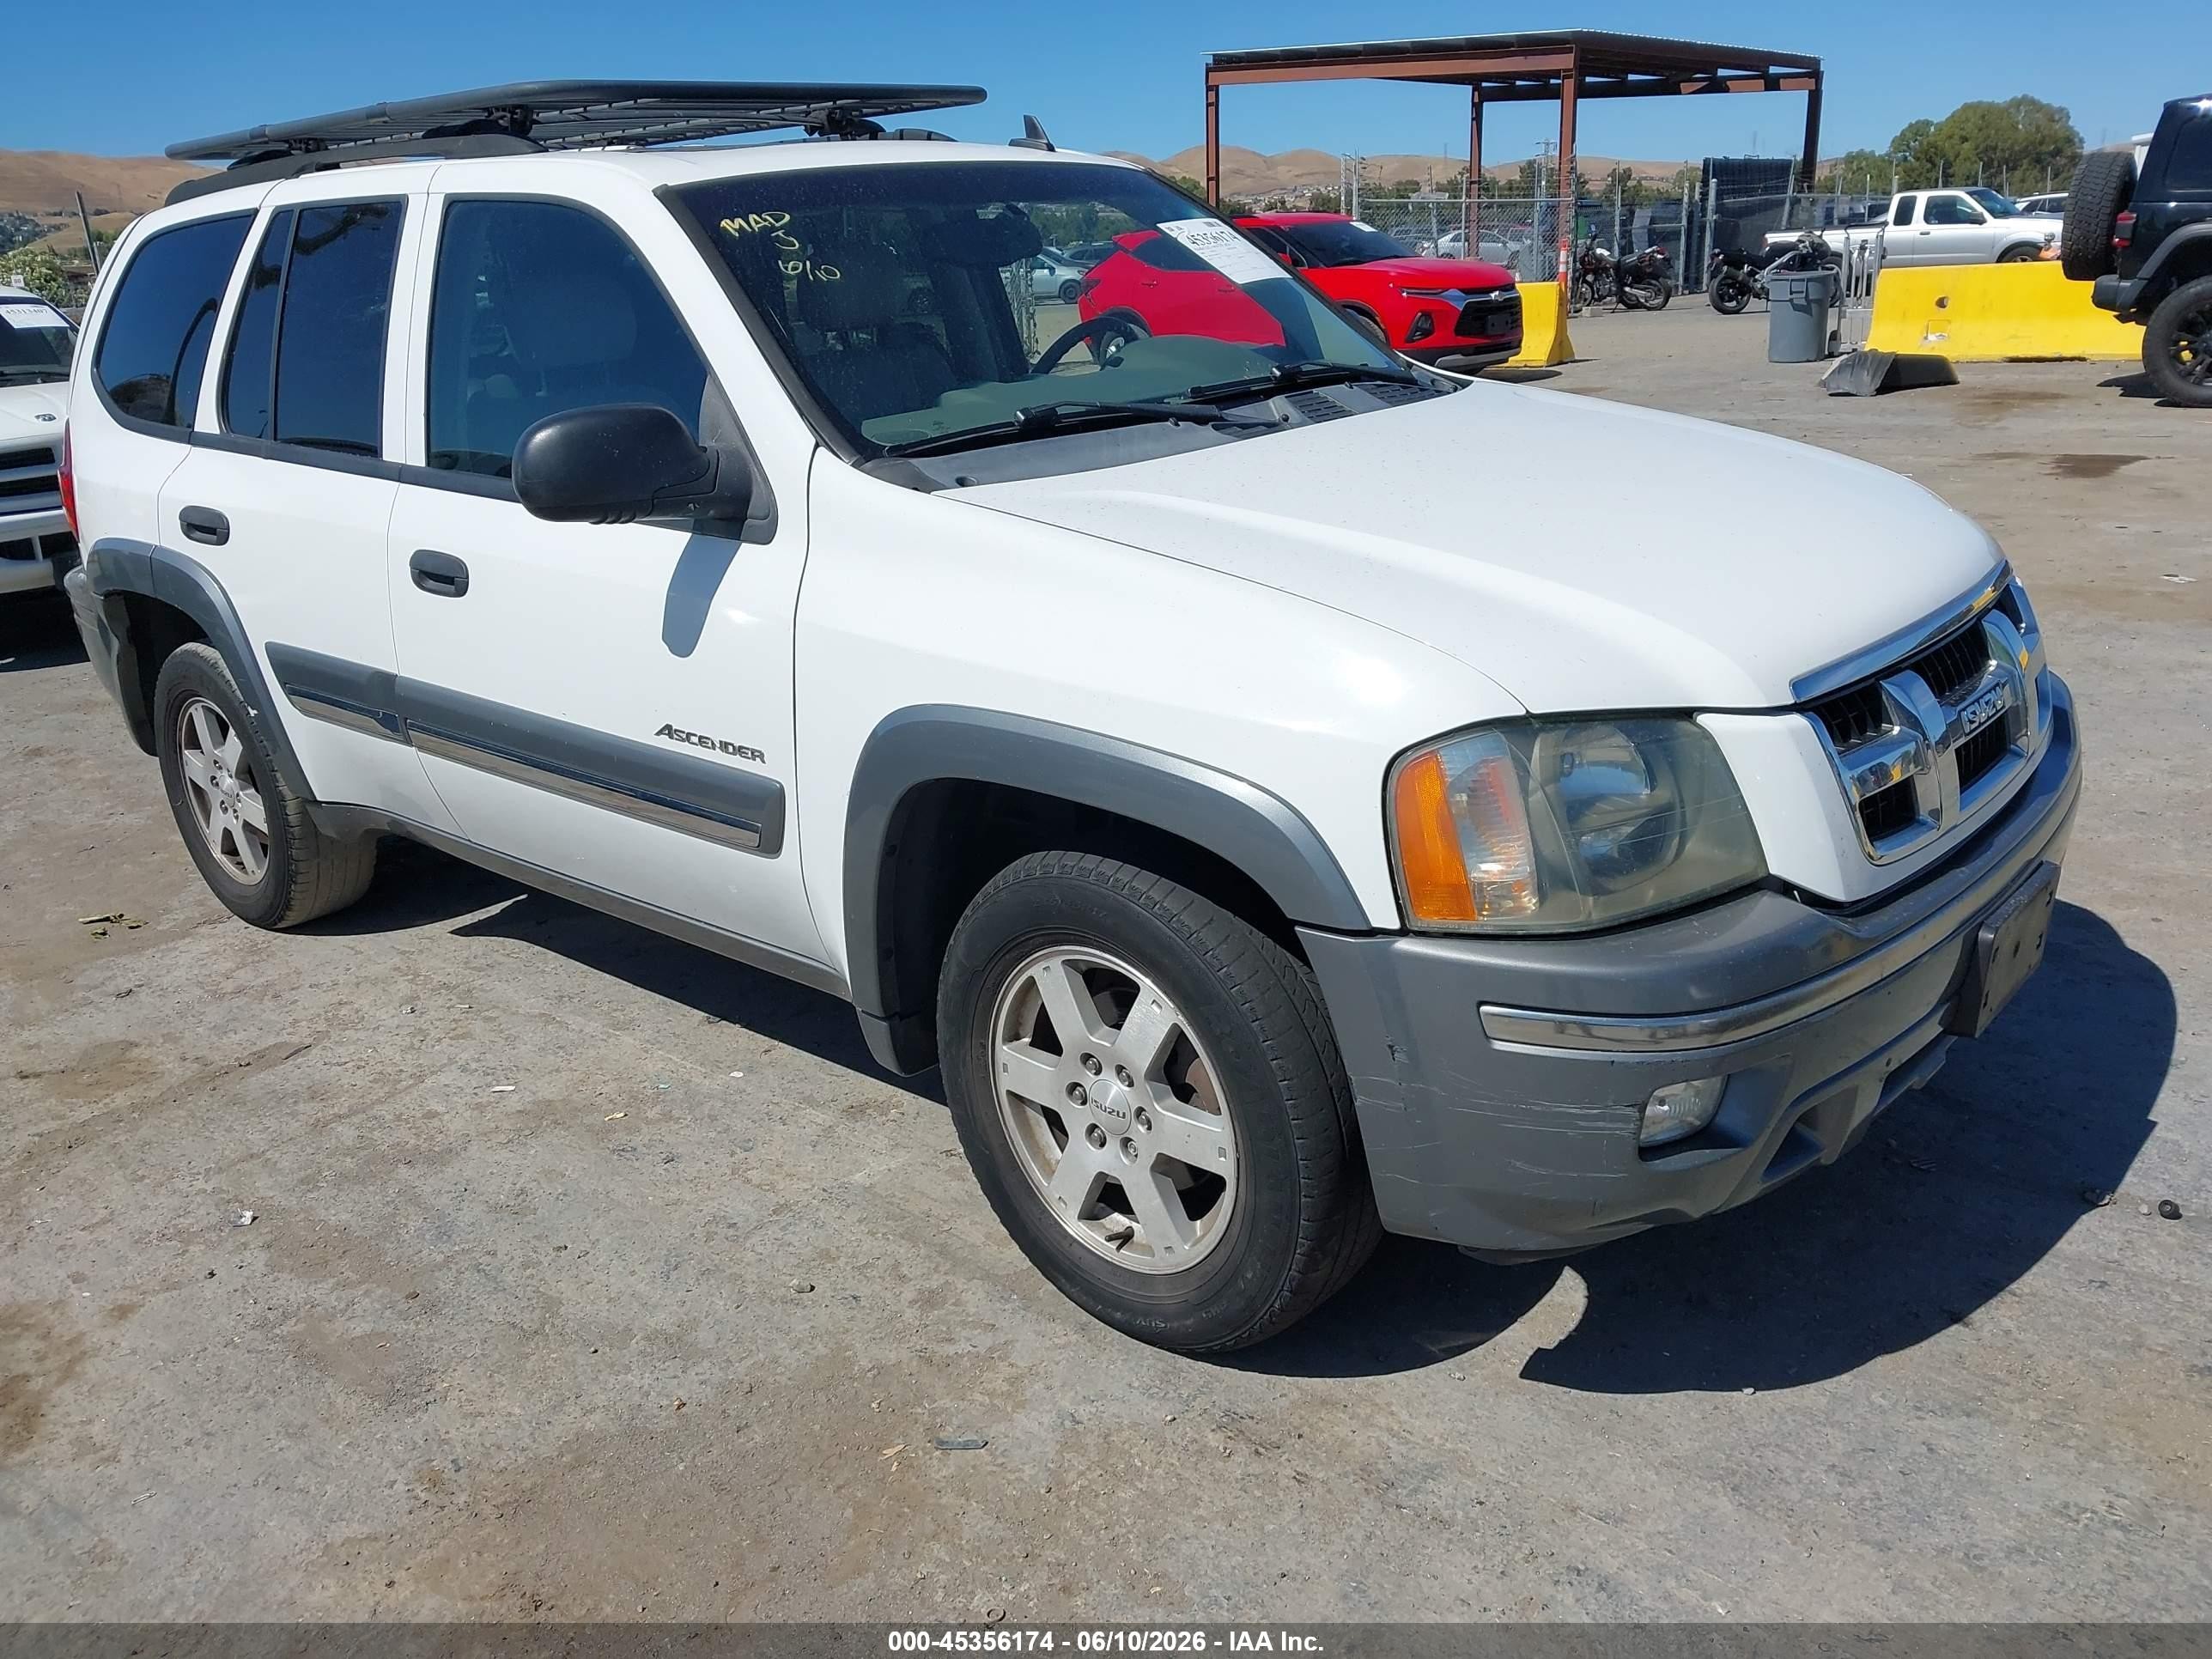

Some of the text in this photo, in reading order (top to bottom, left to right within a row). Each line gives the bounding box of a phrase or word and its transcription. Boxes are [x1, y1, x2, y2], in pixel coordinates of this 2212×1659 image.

[720, 211, 791, 237] MAD
[1186, 229, 1243, 247] 45356174
[778, 259, 841, 282] 6/10
[1960, 684, 2004, 734] ISUZU
[653, 724, 767, 764] ASCENDER
[1091, 1097, 1127, 1120] ISUZU
